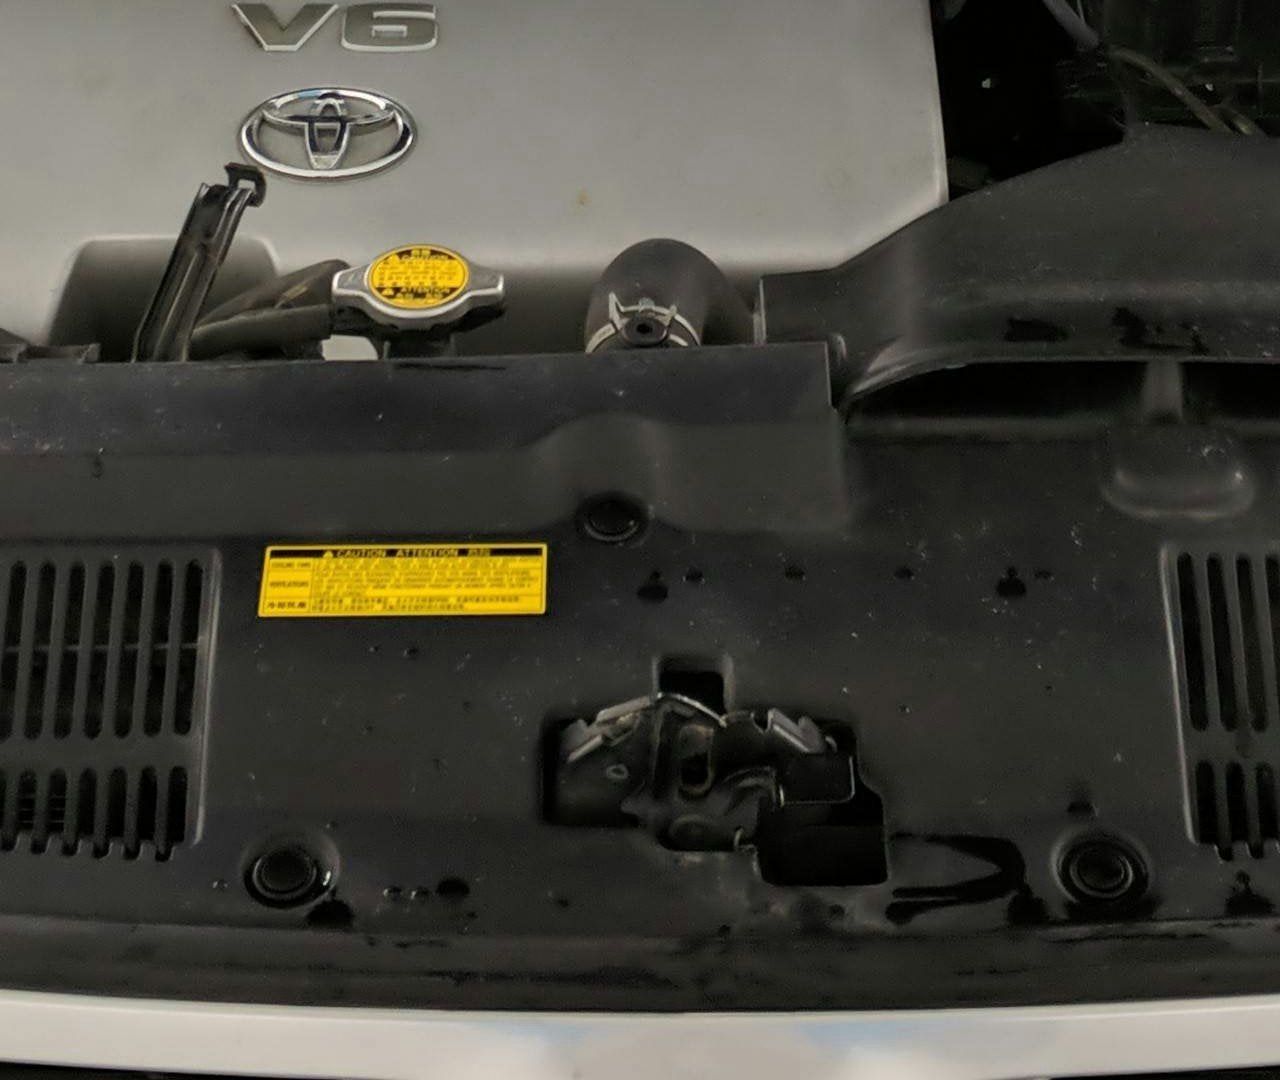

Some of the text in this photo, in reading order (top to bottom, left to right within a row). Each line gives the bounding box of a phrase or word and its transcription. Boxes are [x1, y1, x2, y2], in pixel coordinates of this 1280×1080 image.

[231, 2, 438, 52] V6
[336, 549, 387, 558] CAUTION
[396, 548, 459, 557] ATTENTION
